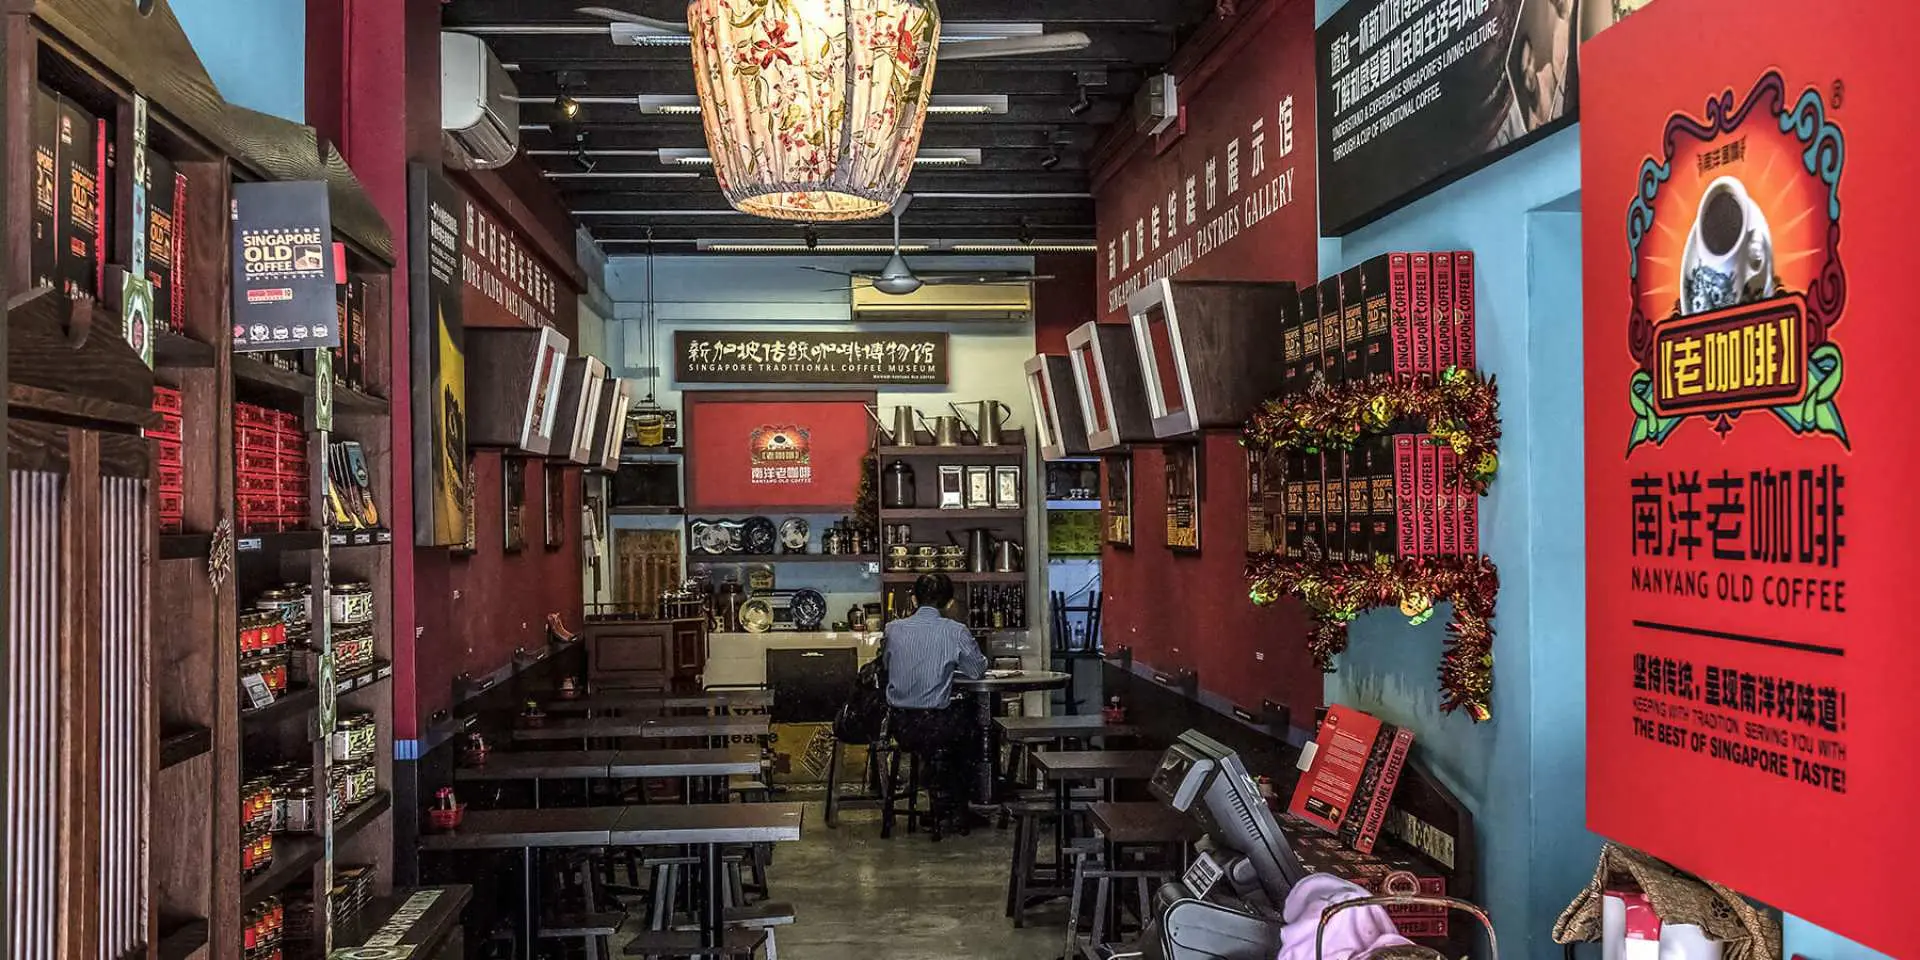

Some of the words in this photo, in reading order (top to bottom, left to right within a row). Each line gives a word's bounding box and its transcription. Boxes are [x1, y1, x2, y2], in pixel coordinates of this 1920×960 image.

[1369, 82, 1402, 118] EXPERIENCE
[1443, 41, 1465, 69] LIVING
[1197, 204, 1241, 259] PASTRIES
[1244, 167, 1294, 229] GALLERY
[242, 233, 322, 247] SINGAPORE
[244, 246, 293, 262] OLD
[246, 261, 293, 273] COFFEE
[688, 340, 936, 364] 新加坡传统咖啡博物馆
[688, 363, 753, 372] SINGAPORE
[759, 363, 836, 372] TRADITIONAL
[841, 364, 882, 372] COFFEE
[888, 364, 936, 373] MUSEUM
[1631, 464, 1846, 568] 南洋老咖啡
[1631, 567, 1709, 599] NANYANG
[1716, 573, 1753, 604] OLD
[1763, 576, 1847, 613] COFFEE
[1632, 716, 1656, 740] THE
[1657, 722, 1688, 749] BEST
[1690, 732, 1708, 753] OF
[1710, 736, 1789, 778] SINGAPORE
[1791, 756, 1846, 795] TASTE!
[1744, 721, 1789, 748] SERVING
[1791, 732, 1814, 755] YOU
[1817, 739, 1847, 761] WITH
[1366, 787, 1391, 834] SINGAPORE
